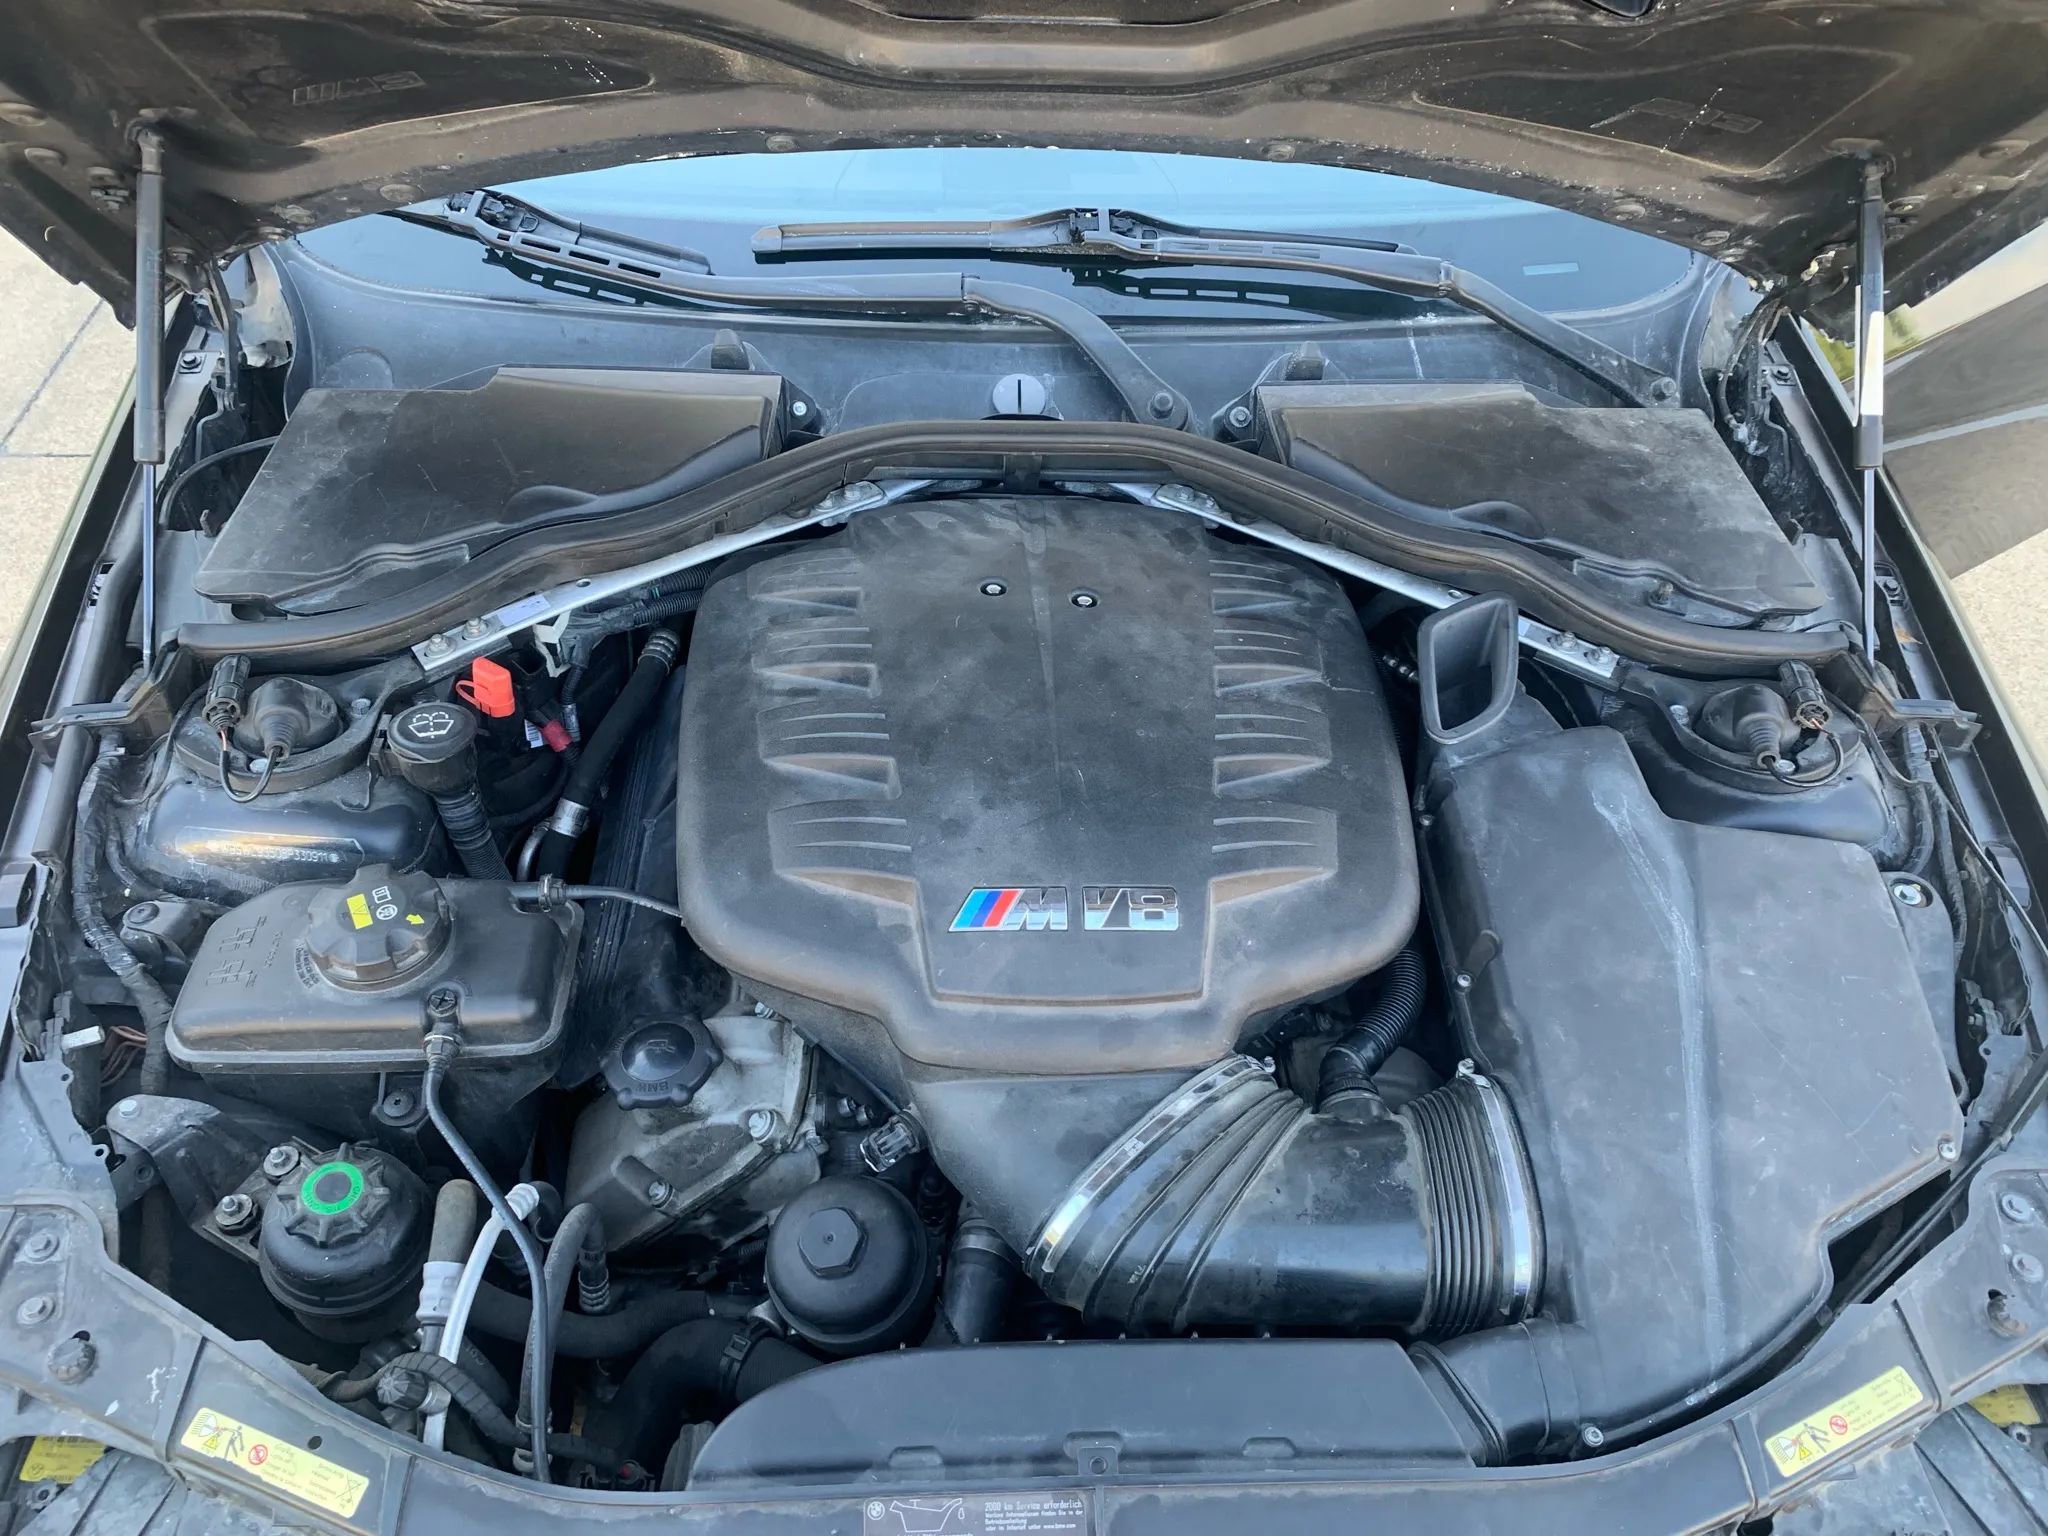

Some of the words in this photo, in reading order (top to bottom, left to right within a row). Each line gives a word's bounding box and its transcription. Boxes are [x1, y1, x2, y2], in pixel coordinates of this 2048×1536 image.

[1082, 887, 1178, 931] V8
[985, 1502, 1001, 1511] 2000
[1004, 1502, 1014, 1510] km
[1016, 1501, 1040, 1510] Service
[1043, 1499, 1082, 1509] erforderlich
